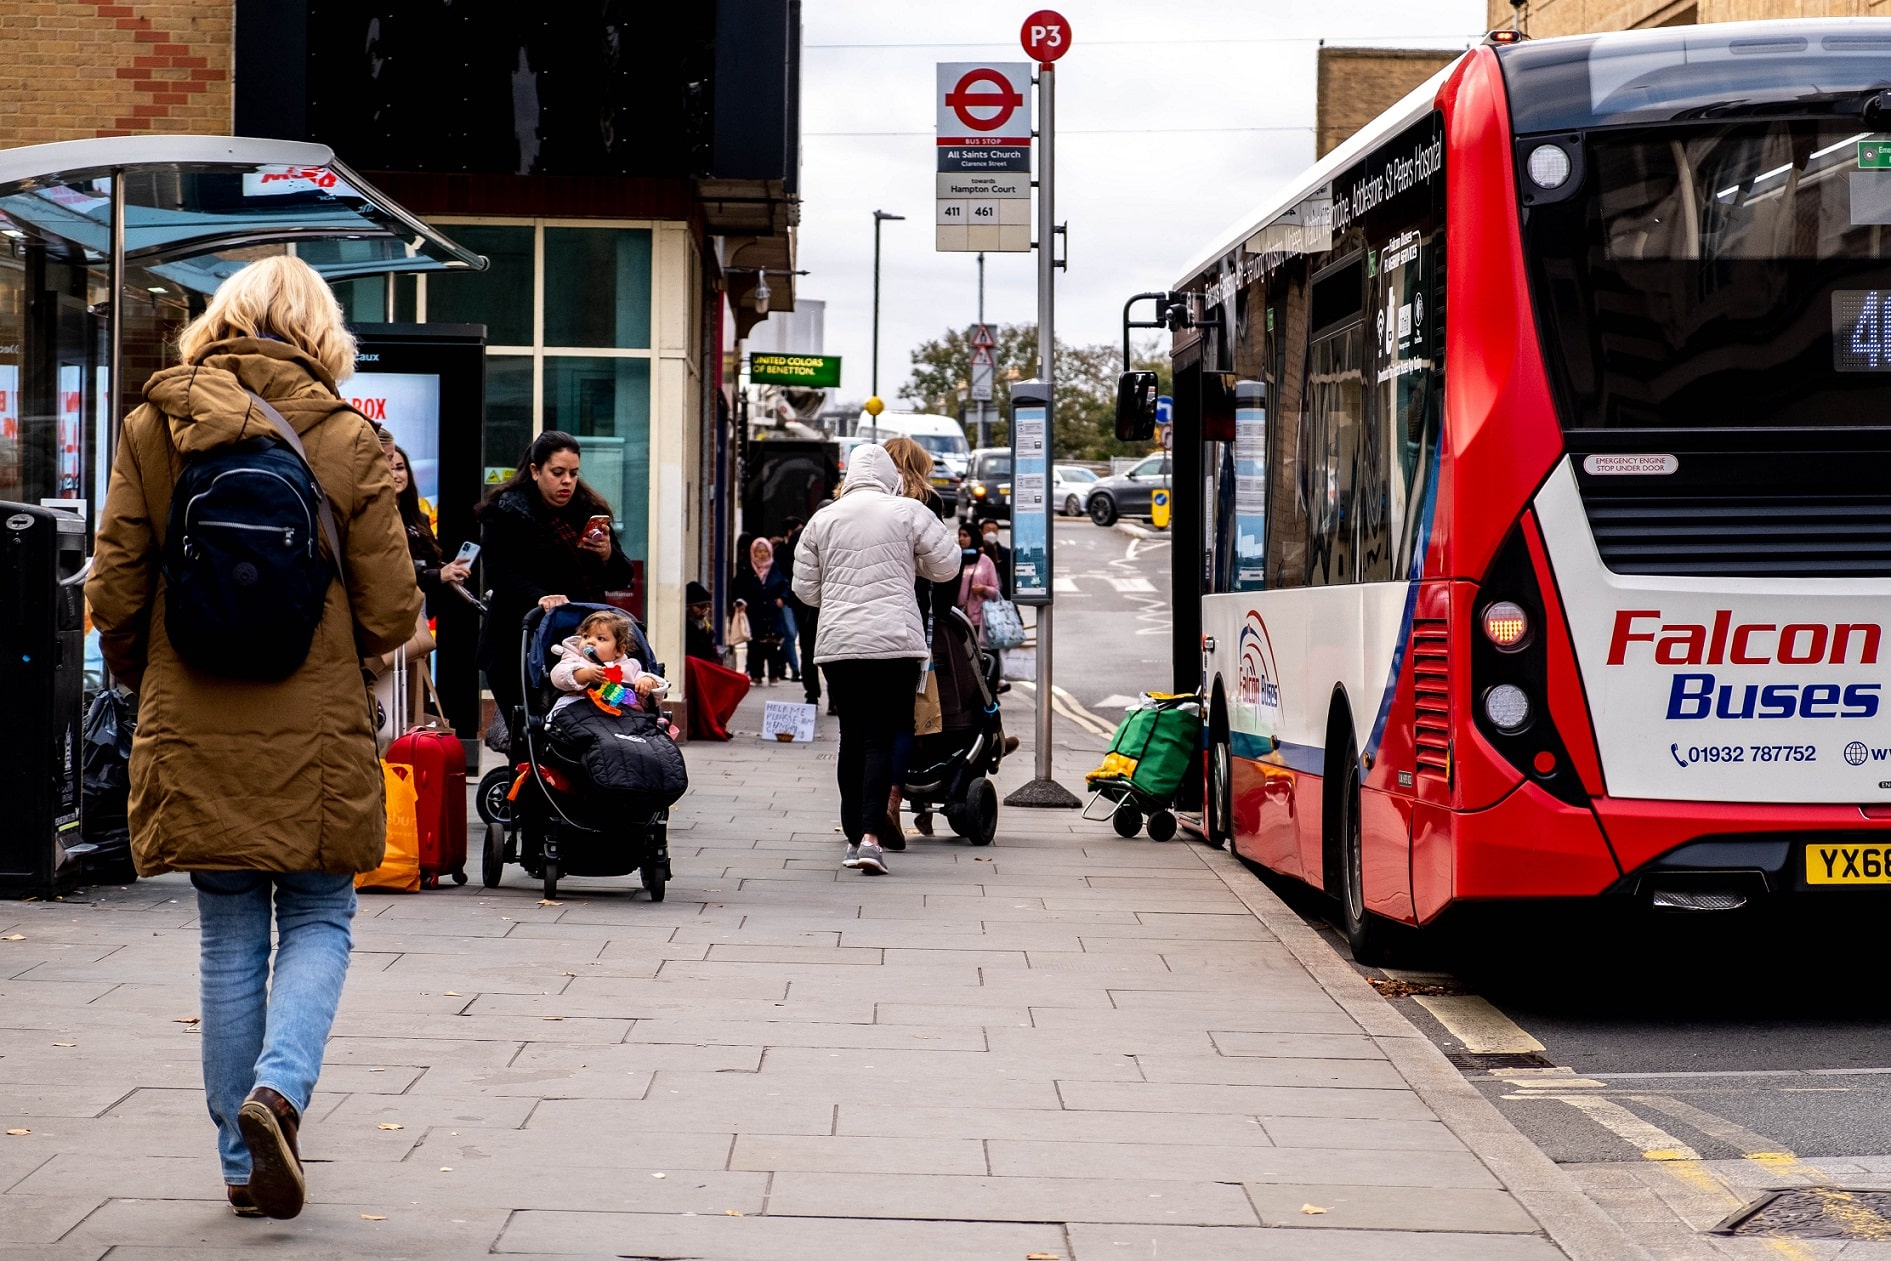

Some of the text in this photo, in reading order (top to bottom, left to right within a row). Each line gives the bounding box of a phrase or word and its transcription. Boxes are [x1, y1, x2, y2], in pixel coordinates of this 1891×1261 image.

[1031, 25, 1062, 47] P3
[947, 150, 1021, 159] All Saints Church
[1415, 130, 1442, 186] Hospital
[950, 185, 1016, 194] Hampton Court
[944, 206, 993, 216] 411 461
[753, 356, 824, 367] UNITED COLORS
[753, 365, 766, 373] OF
[1606, 610, 1882, 665] Falcon
[1239, 666, 1260, 704] Falcon
[1261, 674, 1277, 708] Buses
[1665, 673, 1882, 720] Buses
[1688, 746, 1744, 763] 01932
[1750, 745, 1816, 762] 787752
